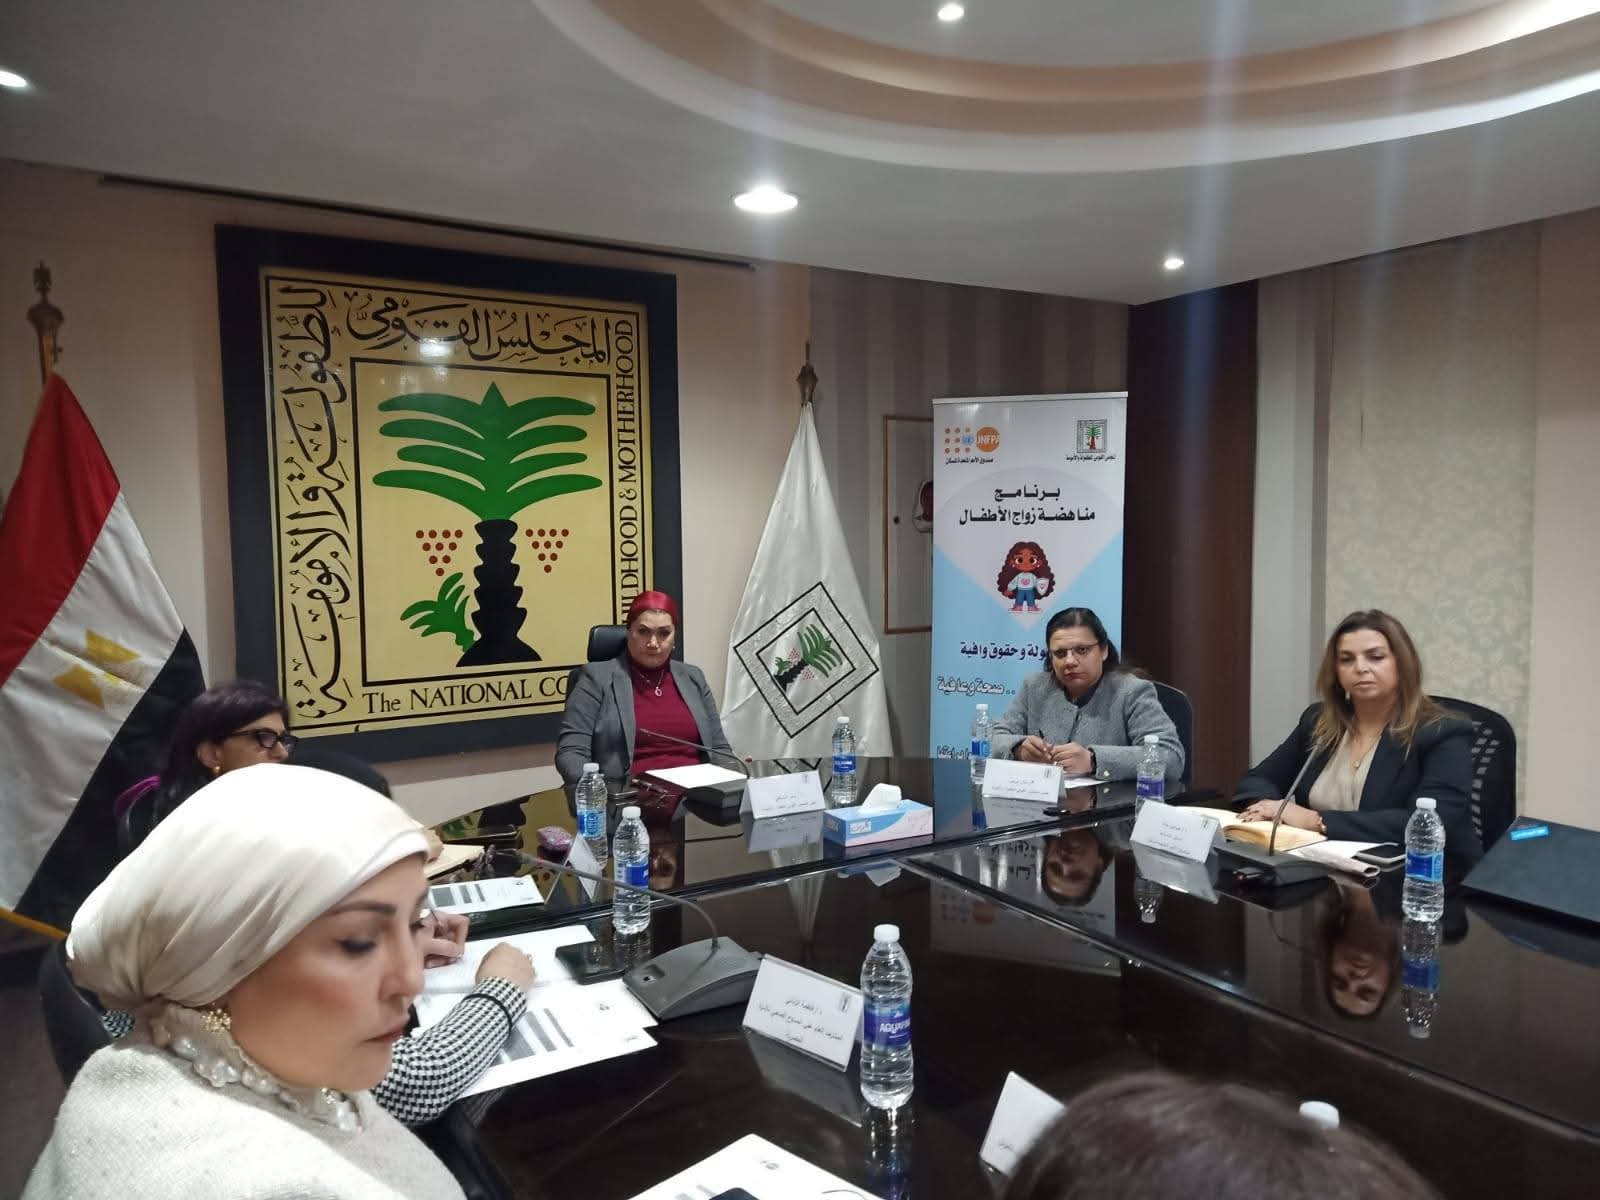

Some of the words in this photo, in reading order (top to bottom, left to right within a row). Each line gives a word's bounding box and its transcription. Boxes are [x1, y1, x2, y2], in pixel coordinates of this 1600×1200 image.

[614, 320, 637, 483] MOTHERHOOD
[618, 488, 638, 501] &
[994, 484, 1061, 501] برنامج
[959, 506, 1011, 525] الأطفال
[1012, 508, 1035, 525] زواج
[1038, 507, 1096, 522] مناهضة
[960, 641, 988, 659] وافية
[362, 691, 401, 713] The
[409, 679, 532, 710] NATIONAL
